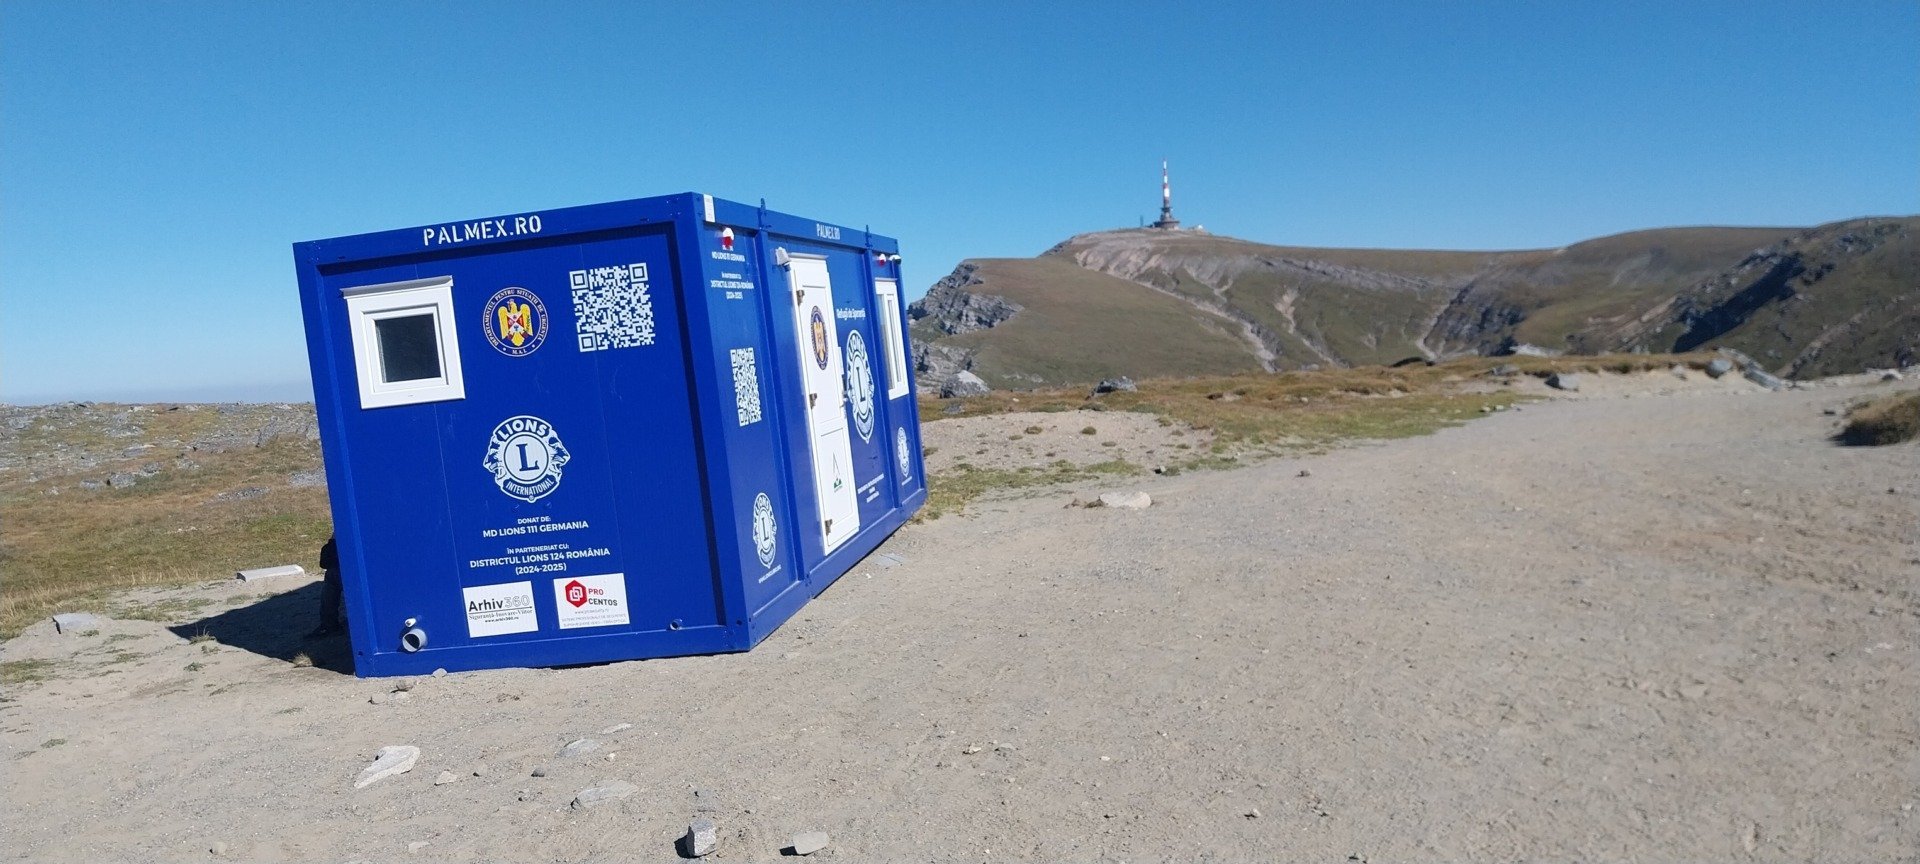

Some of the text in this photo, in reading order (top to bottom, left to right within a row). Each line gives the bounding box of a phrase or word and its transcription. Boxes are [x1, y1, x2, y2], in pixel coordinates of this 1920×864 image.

[423, 215, 542, 246] PALMEX.RO
[494, 289, 515, 301] PENTRU
[498, 419, 547, 440] LIONS
[516, 443, 540, 471] L
[505, 478, 555, 495] INTERNATIONAL
[483, 520, 589, 538] MD LIONS 111 GERMANIA
[470, 548, 610, 568] DISTRICTUL LIONS 124 ROMÂNIA
[515, 544, 558, 554] PARTENERIAT
[515, 562, 567, 575] (2024-2025)
[469, 594, 531, 612] Arhiv360
[588, 598, 618, 606] CENTOS
